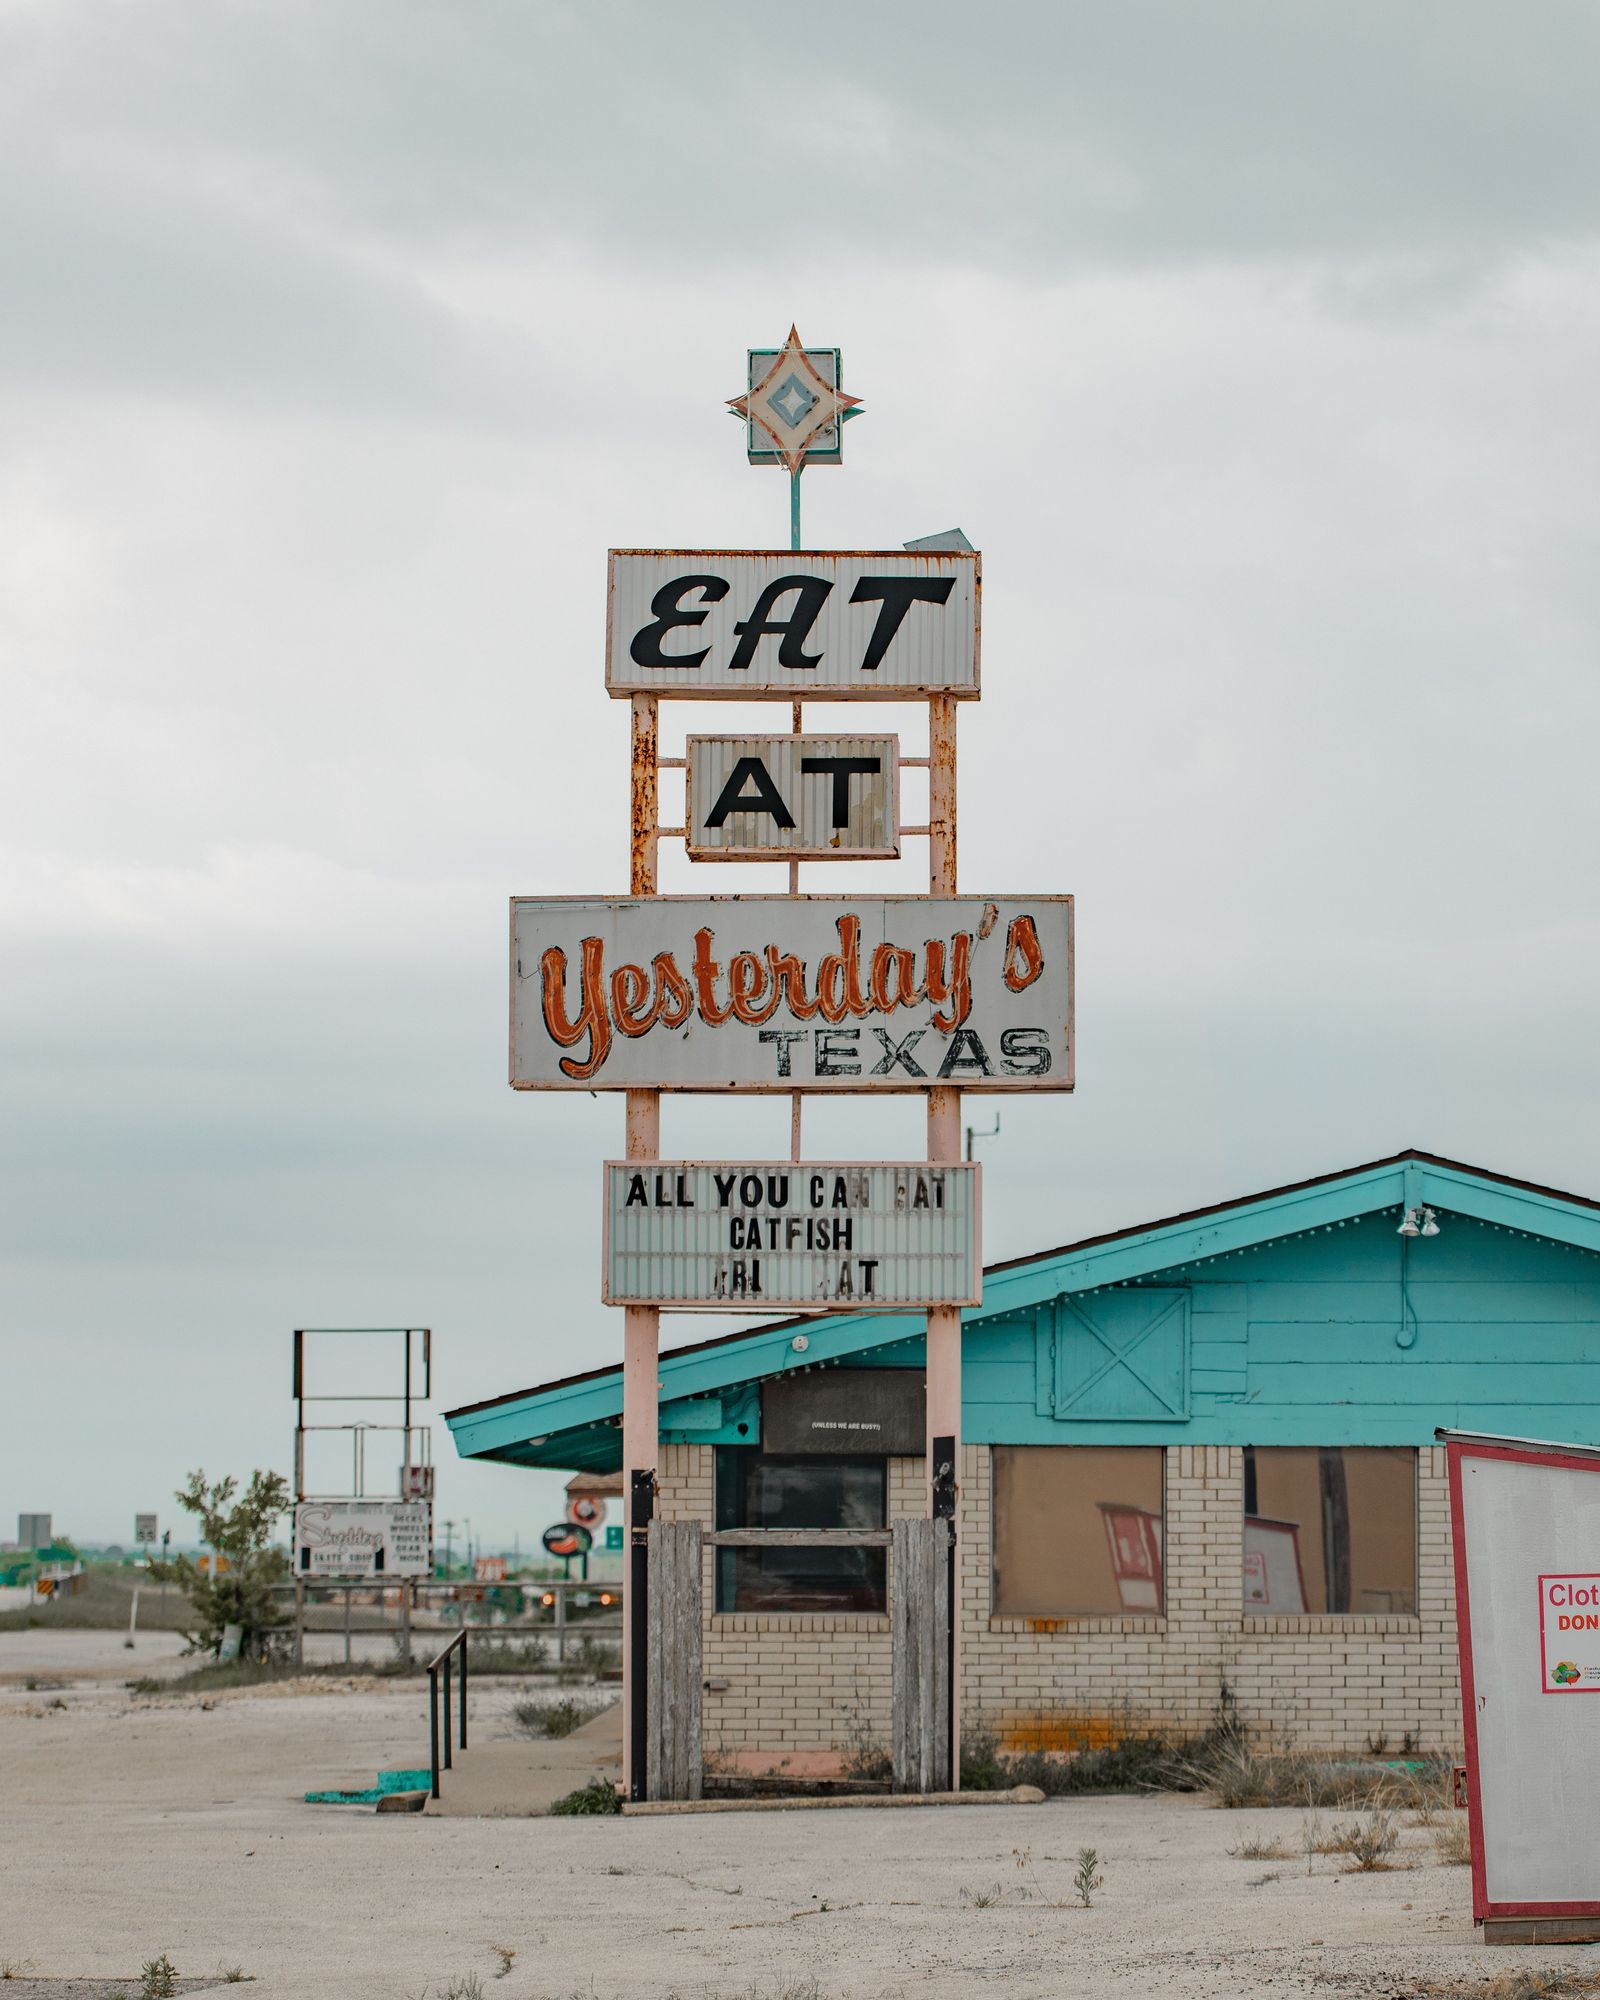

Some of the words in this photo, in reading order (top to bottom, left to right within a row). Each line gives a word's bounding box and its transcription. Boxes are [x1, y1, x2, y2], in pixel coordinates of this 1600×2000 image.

[630, 575, 957, 669] EAT
[703, 757, 881, 828] AT
[541, 903, 1043, 1080] Yesterday's
[758, 1028, 1051, 1077] TEXAS
[626, 1174, 694, 1207] ALL
[714, 1175, 788, 1207] YOU
[730, 1217, 852, 1250] CATFISH
[812, 1422, 837, 1430] (UNLESS
[838, 1422, 848, 1430] WE
[1549, 1584, 1599, 1606] Clot
[1558, 1615, 1599, 1630] DON
